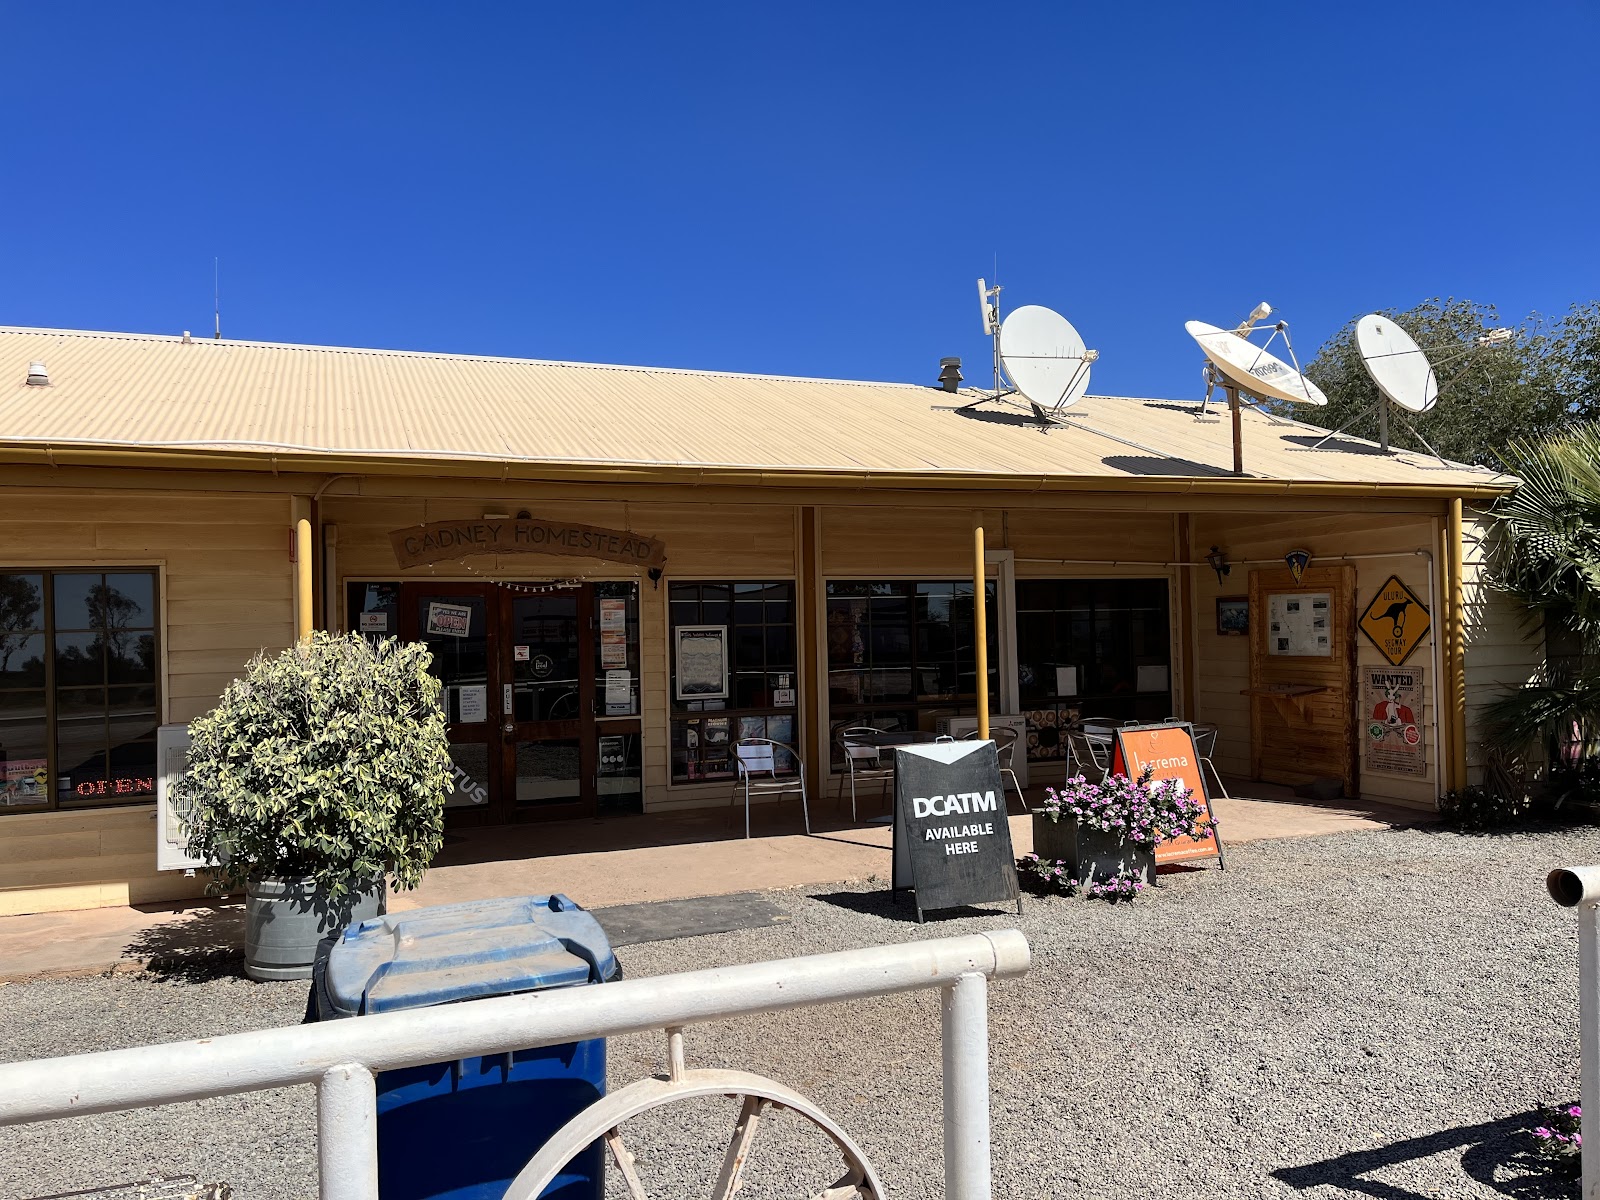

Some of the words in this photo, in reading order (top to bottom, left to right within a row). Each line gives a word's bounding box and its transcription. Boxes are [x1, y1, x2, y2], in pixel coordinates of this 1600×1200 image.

[404, 524, 503, 556] CADNEY
[515, 524, 651, 559] HOMESTEAD
[1383, 591, 1404, 601] ULURU
[437, 615, 467, 630] OPEN
[1384, 638, 1407, 648] SEGWAY
[1387, 647, 1402, 655] TOUR
[1371, 673, 1413, 686] WANTED
[77, 778, 153, 796] OPEN
[912, 791, 998, 819] DCATM
[925, 823, 994, 841] AVAILABLE
[945, 841, 979, 856] HERE
